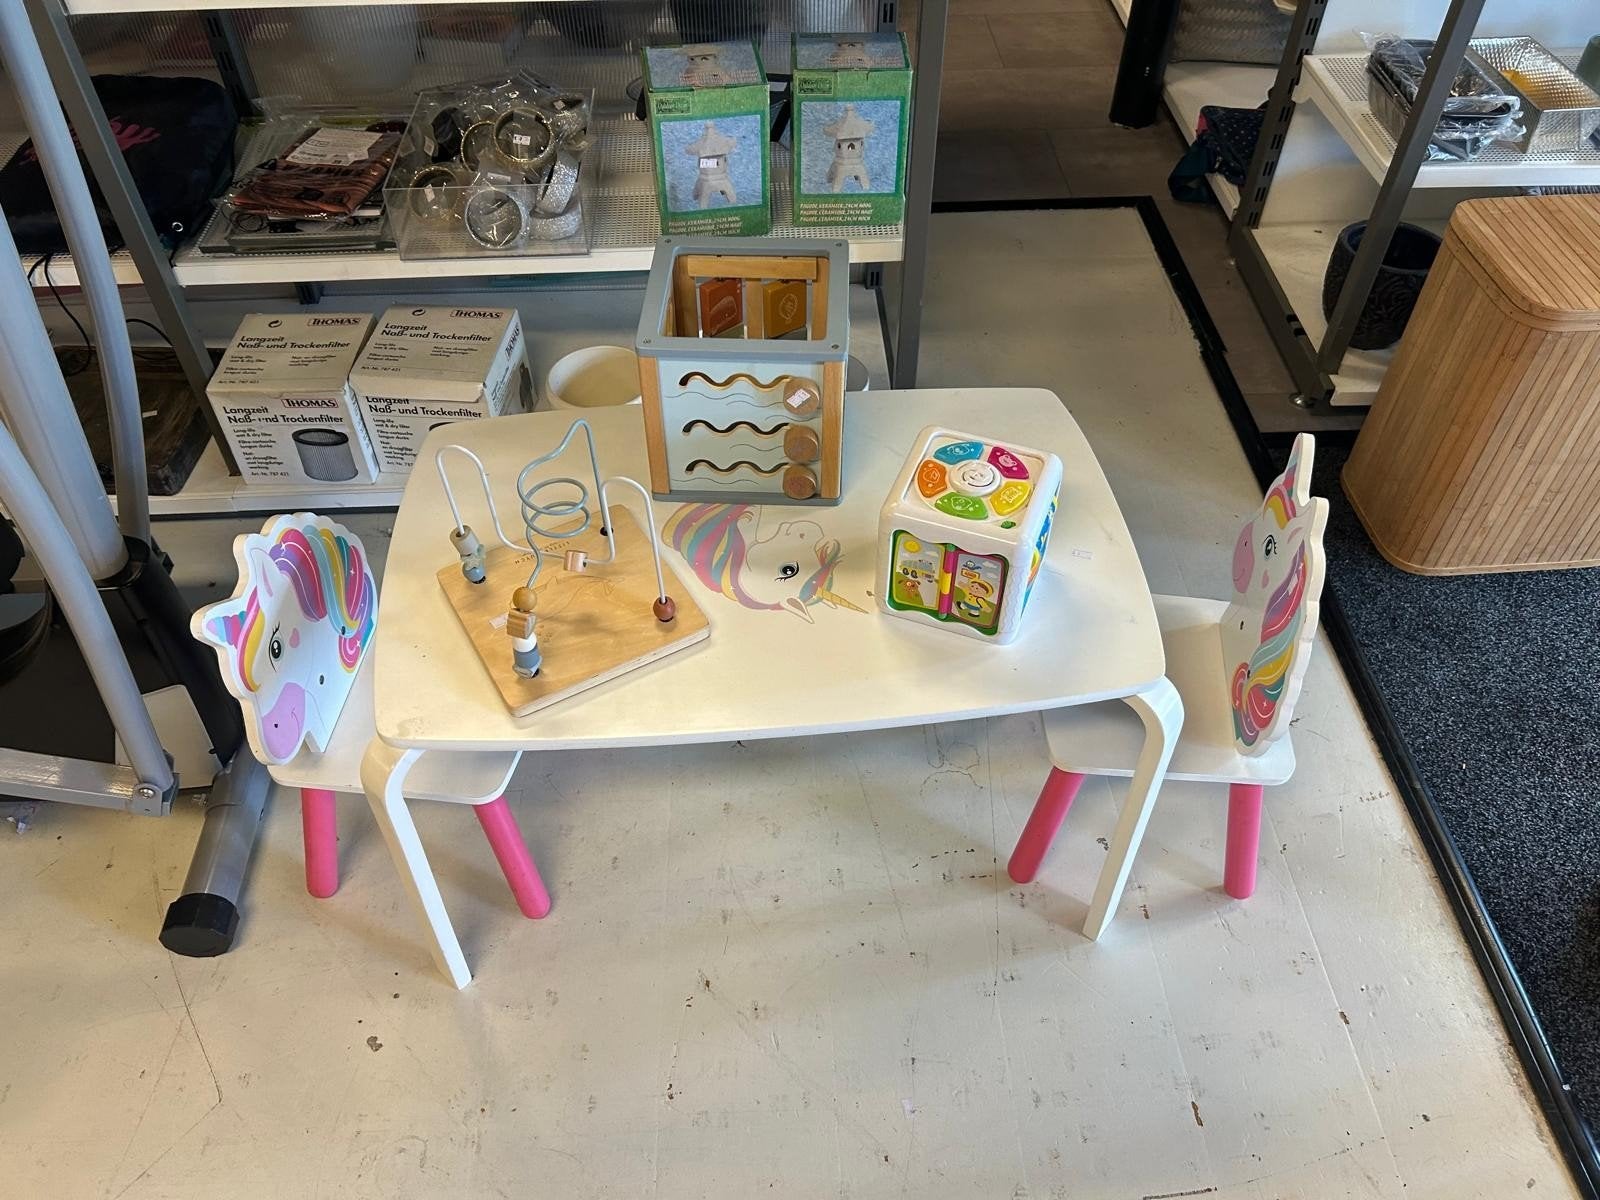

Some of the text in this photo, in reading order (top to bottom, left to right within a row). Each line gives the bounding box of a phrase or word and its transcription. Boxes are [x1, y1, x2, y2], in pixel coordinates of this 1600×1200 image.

[454, 309, 501, 319] THOMAS
[312, 318, 360, 326] THOMAS
[384, 322, 428, 331] Langzeit
[240, 335, 285, 344] Langzeit
[409, 331, 431, 339] und
[432, 332, 493, 342] Trockenfilter
[289, 341, 351, 349] Trockenfilter
[285, 398, 336, 408] THOMAS
[366, 396, 410, 406] Langzeit
[223, 406, 269, 415] Langzeit
[369, 404, 483, 418] Naß- und Trockenfilter
[280, 414, 343, 424] Trockenfilter
